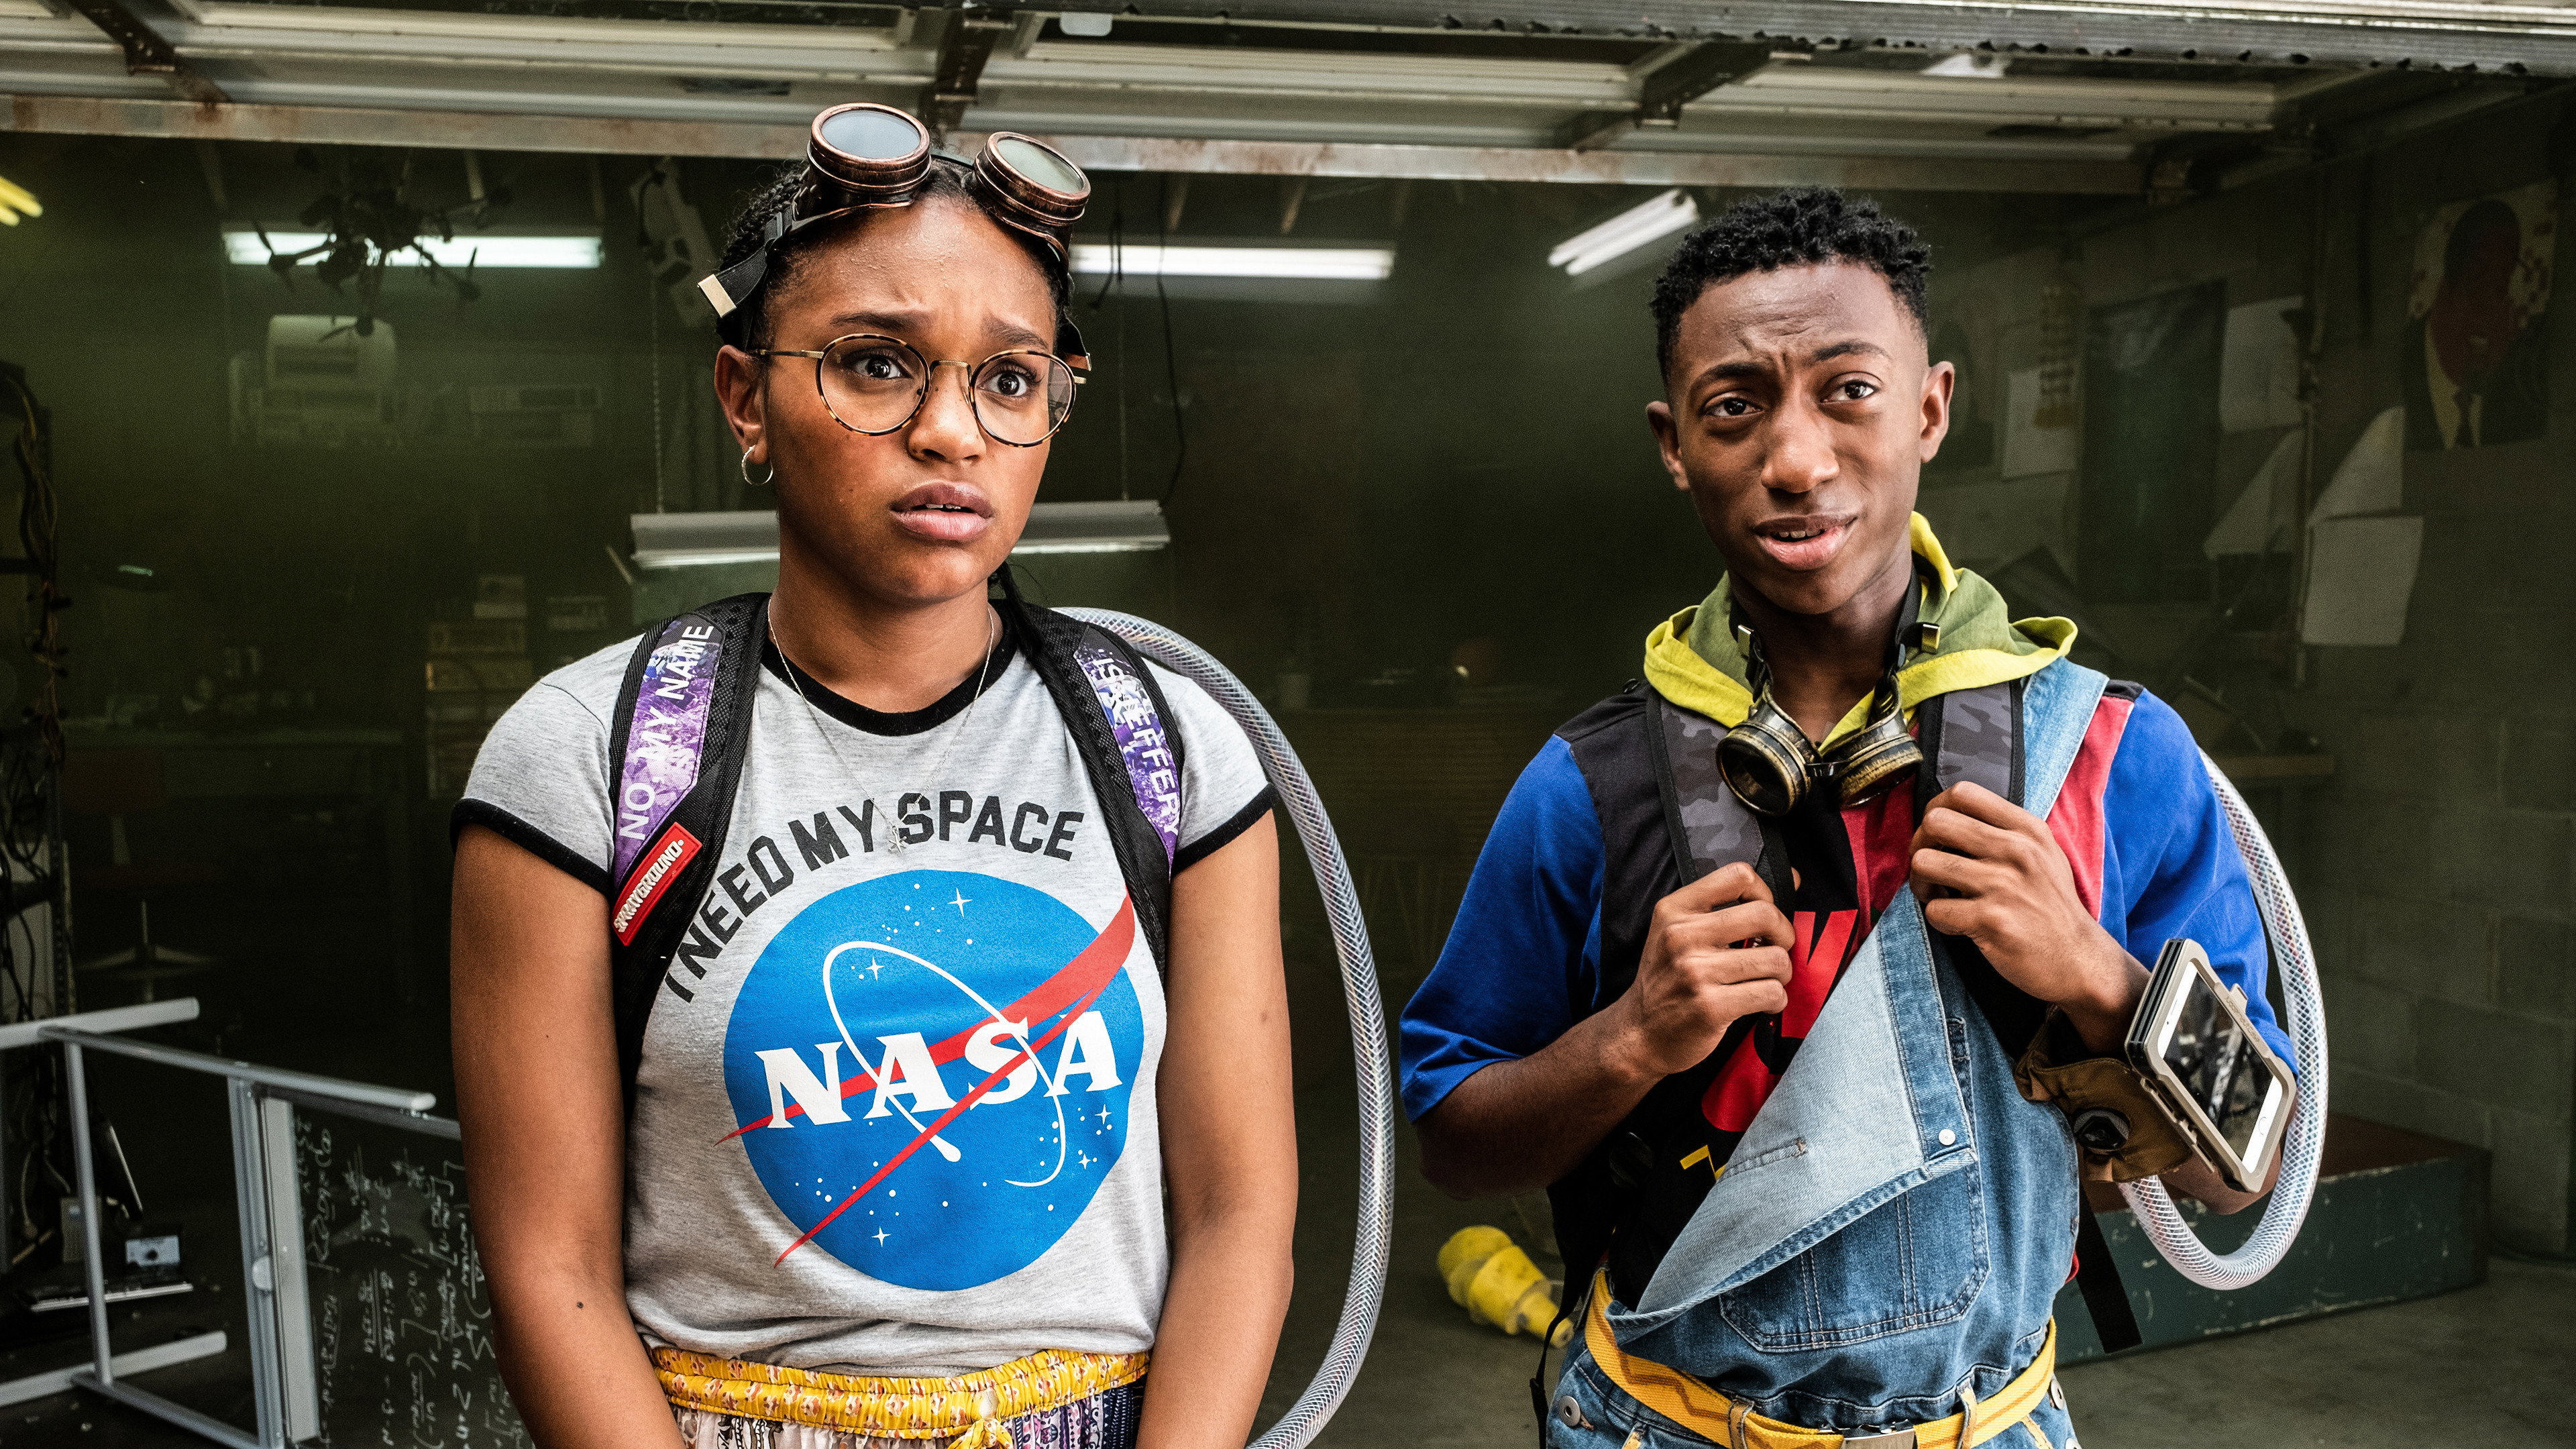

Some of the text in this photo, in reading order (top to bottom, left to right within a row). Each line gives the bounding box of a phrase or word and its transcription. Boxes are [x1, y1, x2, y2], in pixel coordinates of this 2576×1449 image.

[655, 626, 714, 700] NAME
[1091, 657, 1125, 682] IS
[635, 706, 677, 760] MY
[665, 790, 1084, 1003] I NEED MY SPACE
[754, 1010, 1123, 1128] NASA
